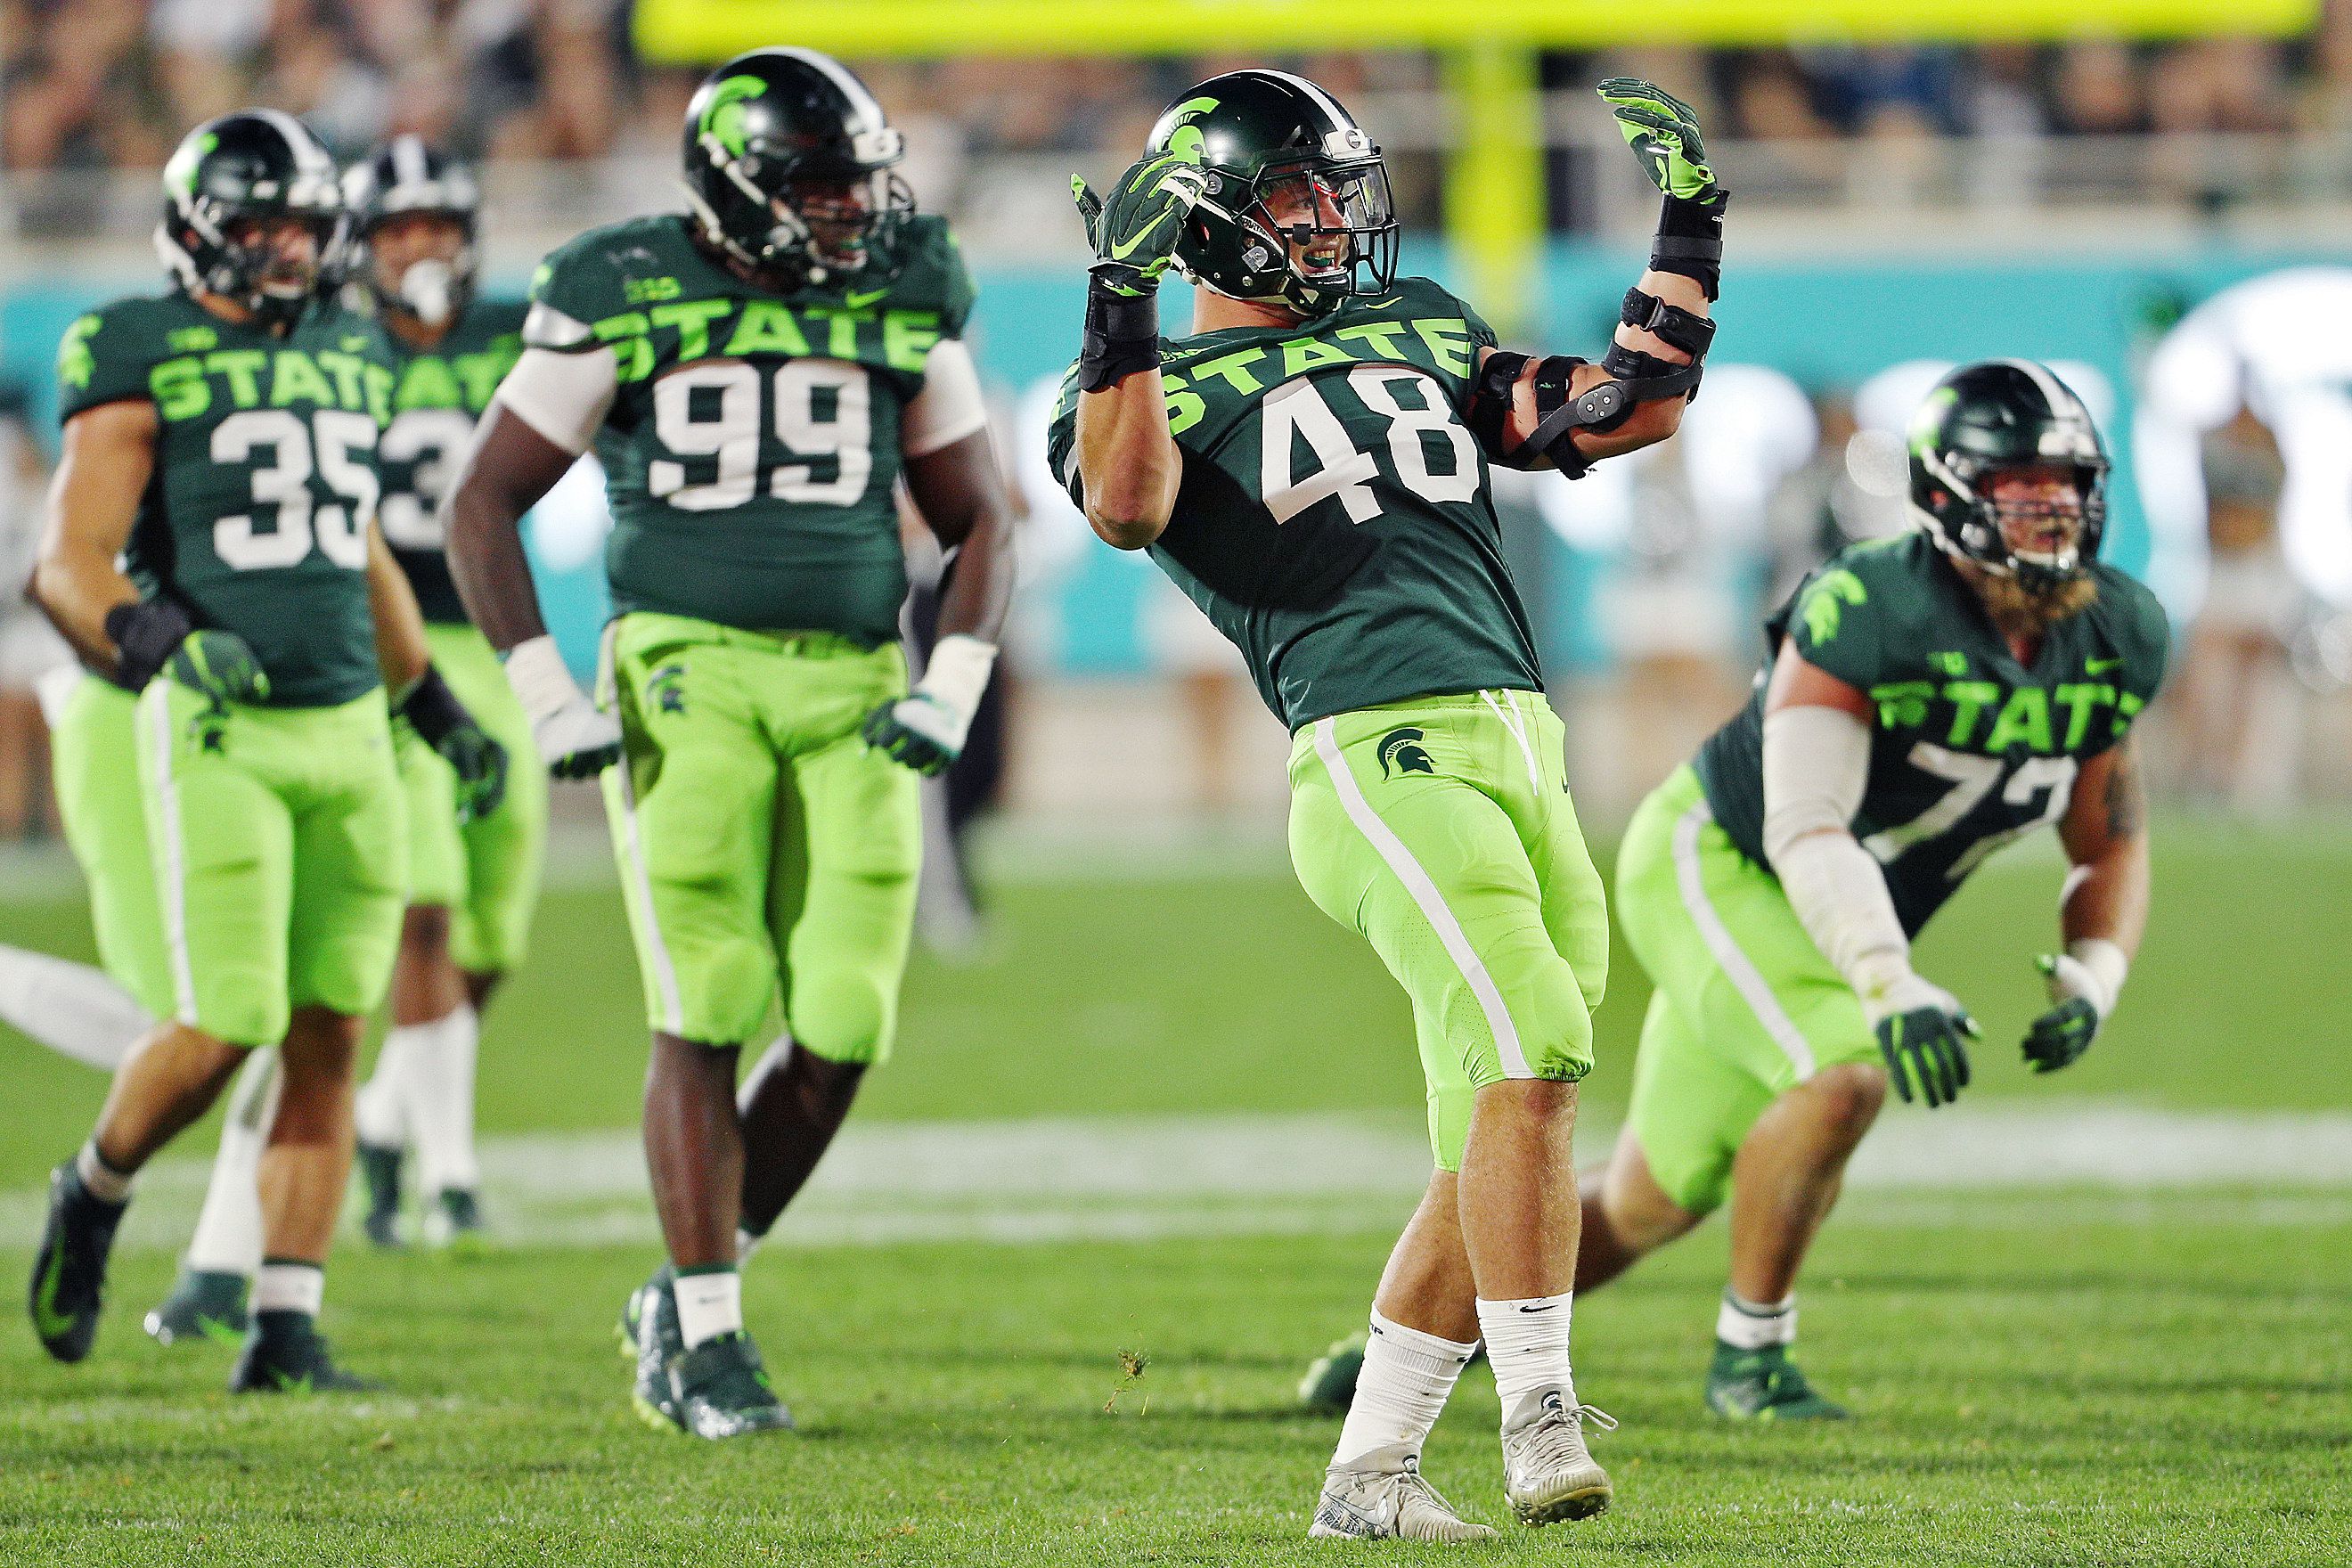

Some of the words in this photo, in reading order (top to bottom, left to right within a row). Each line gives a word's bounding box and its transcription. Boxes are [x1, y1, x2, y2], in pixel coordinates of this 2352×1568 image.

[593, 298, 939, 383] STATE
[1159, 318, 1471, 438] STATE
[210, 409, 380, 572] 35
[649, 358, 872, 512] 99
[1262, 363, 1480, 525] 48
